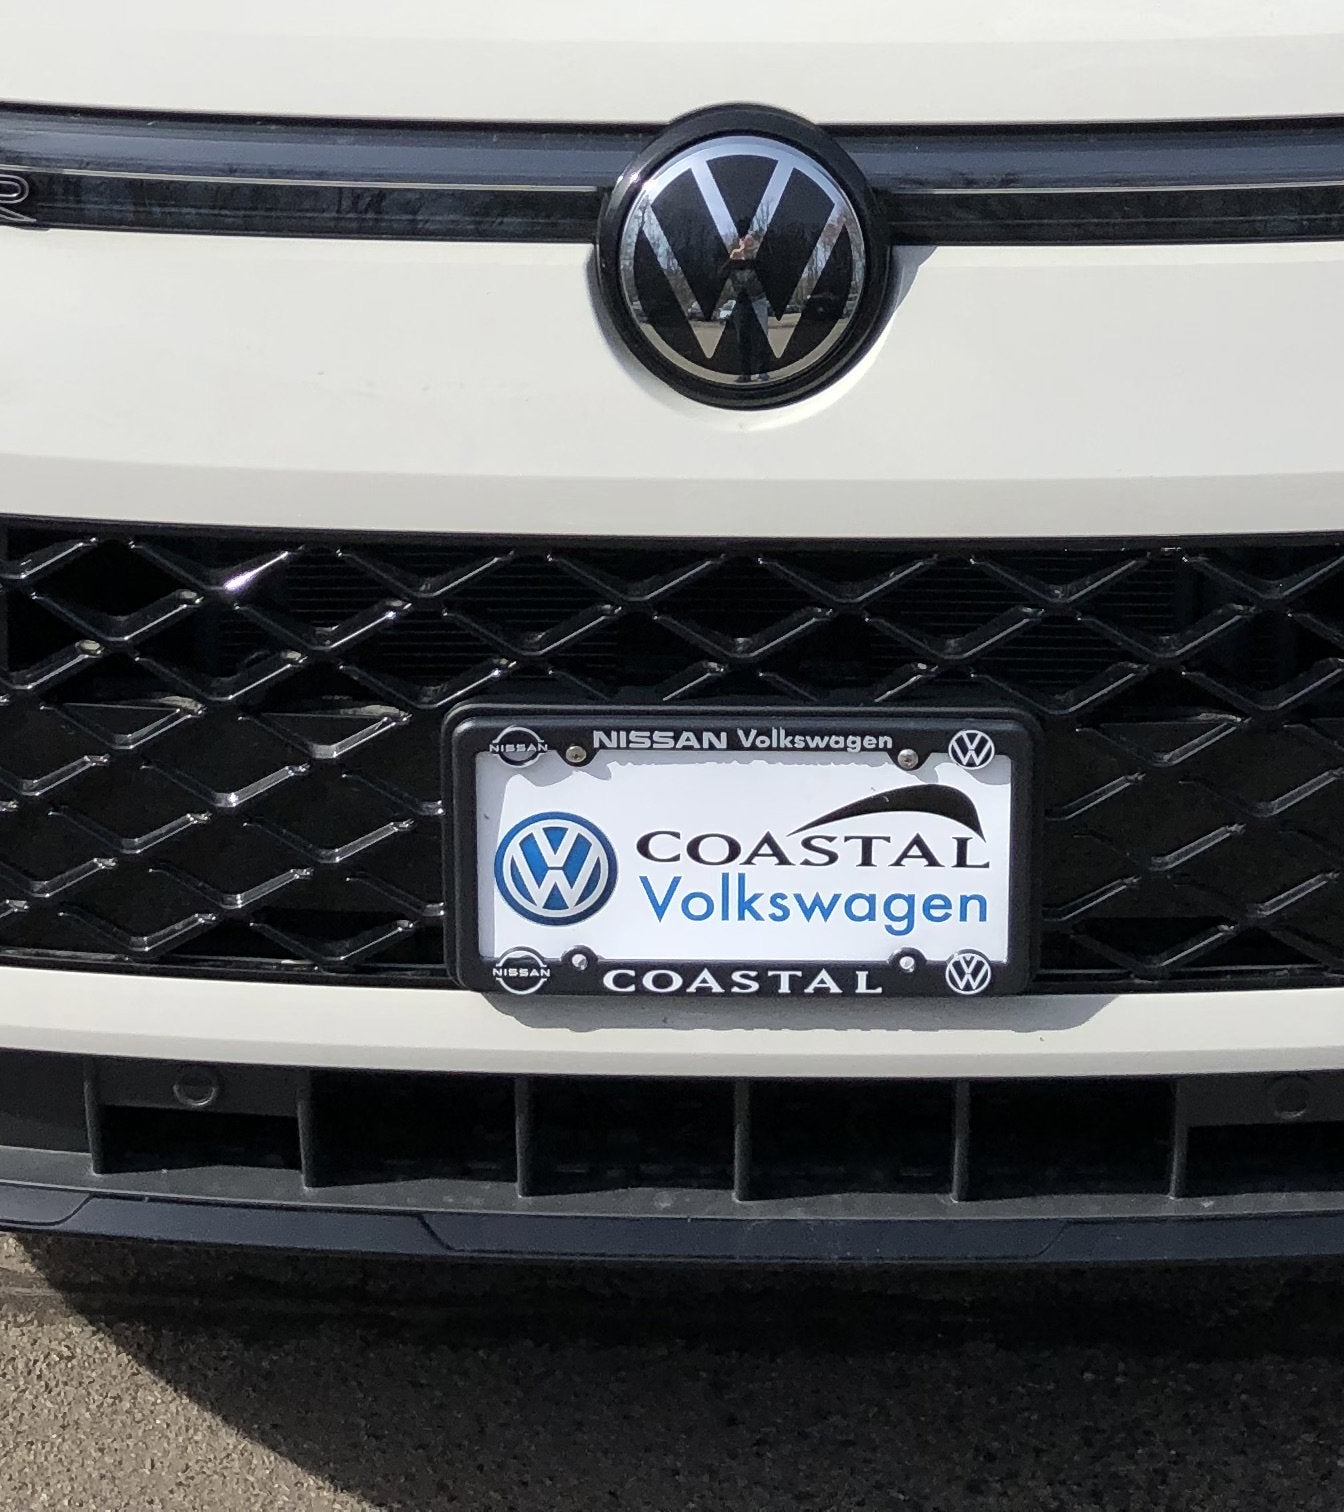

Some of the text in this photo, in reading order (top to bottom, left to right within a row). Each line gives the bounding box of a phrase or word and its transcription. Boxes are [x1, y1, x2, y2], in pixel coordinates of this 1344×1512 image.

[489, 741, 549, 755] NISSAN
[592, 727, 893, 752] NISSAN Volkswagen
[636, 830, 990, 869] COASTAL
[639, 873, 988, 935] Volkswagen
[492, 966, 551, 978] NISSAN
[602, 968, 882, 994] COASTAL
